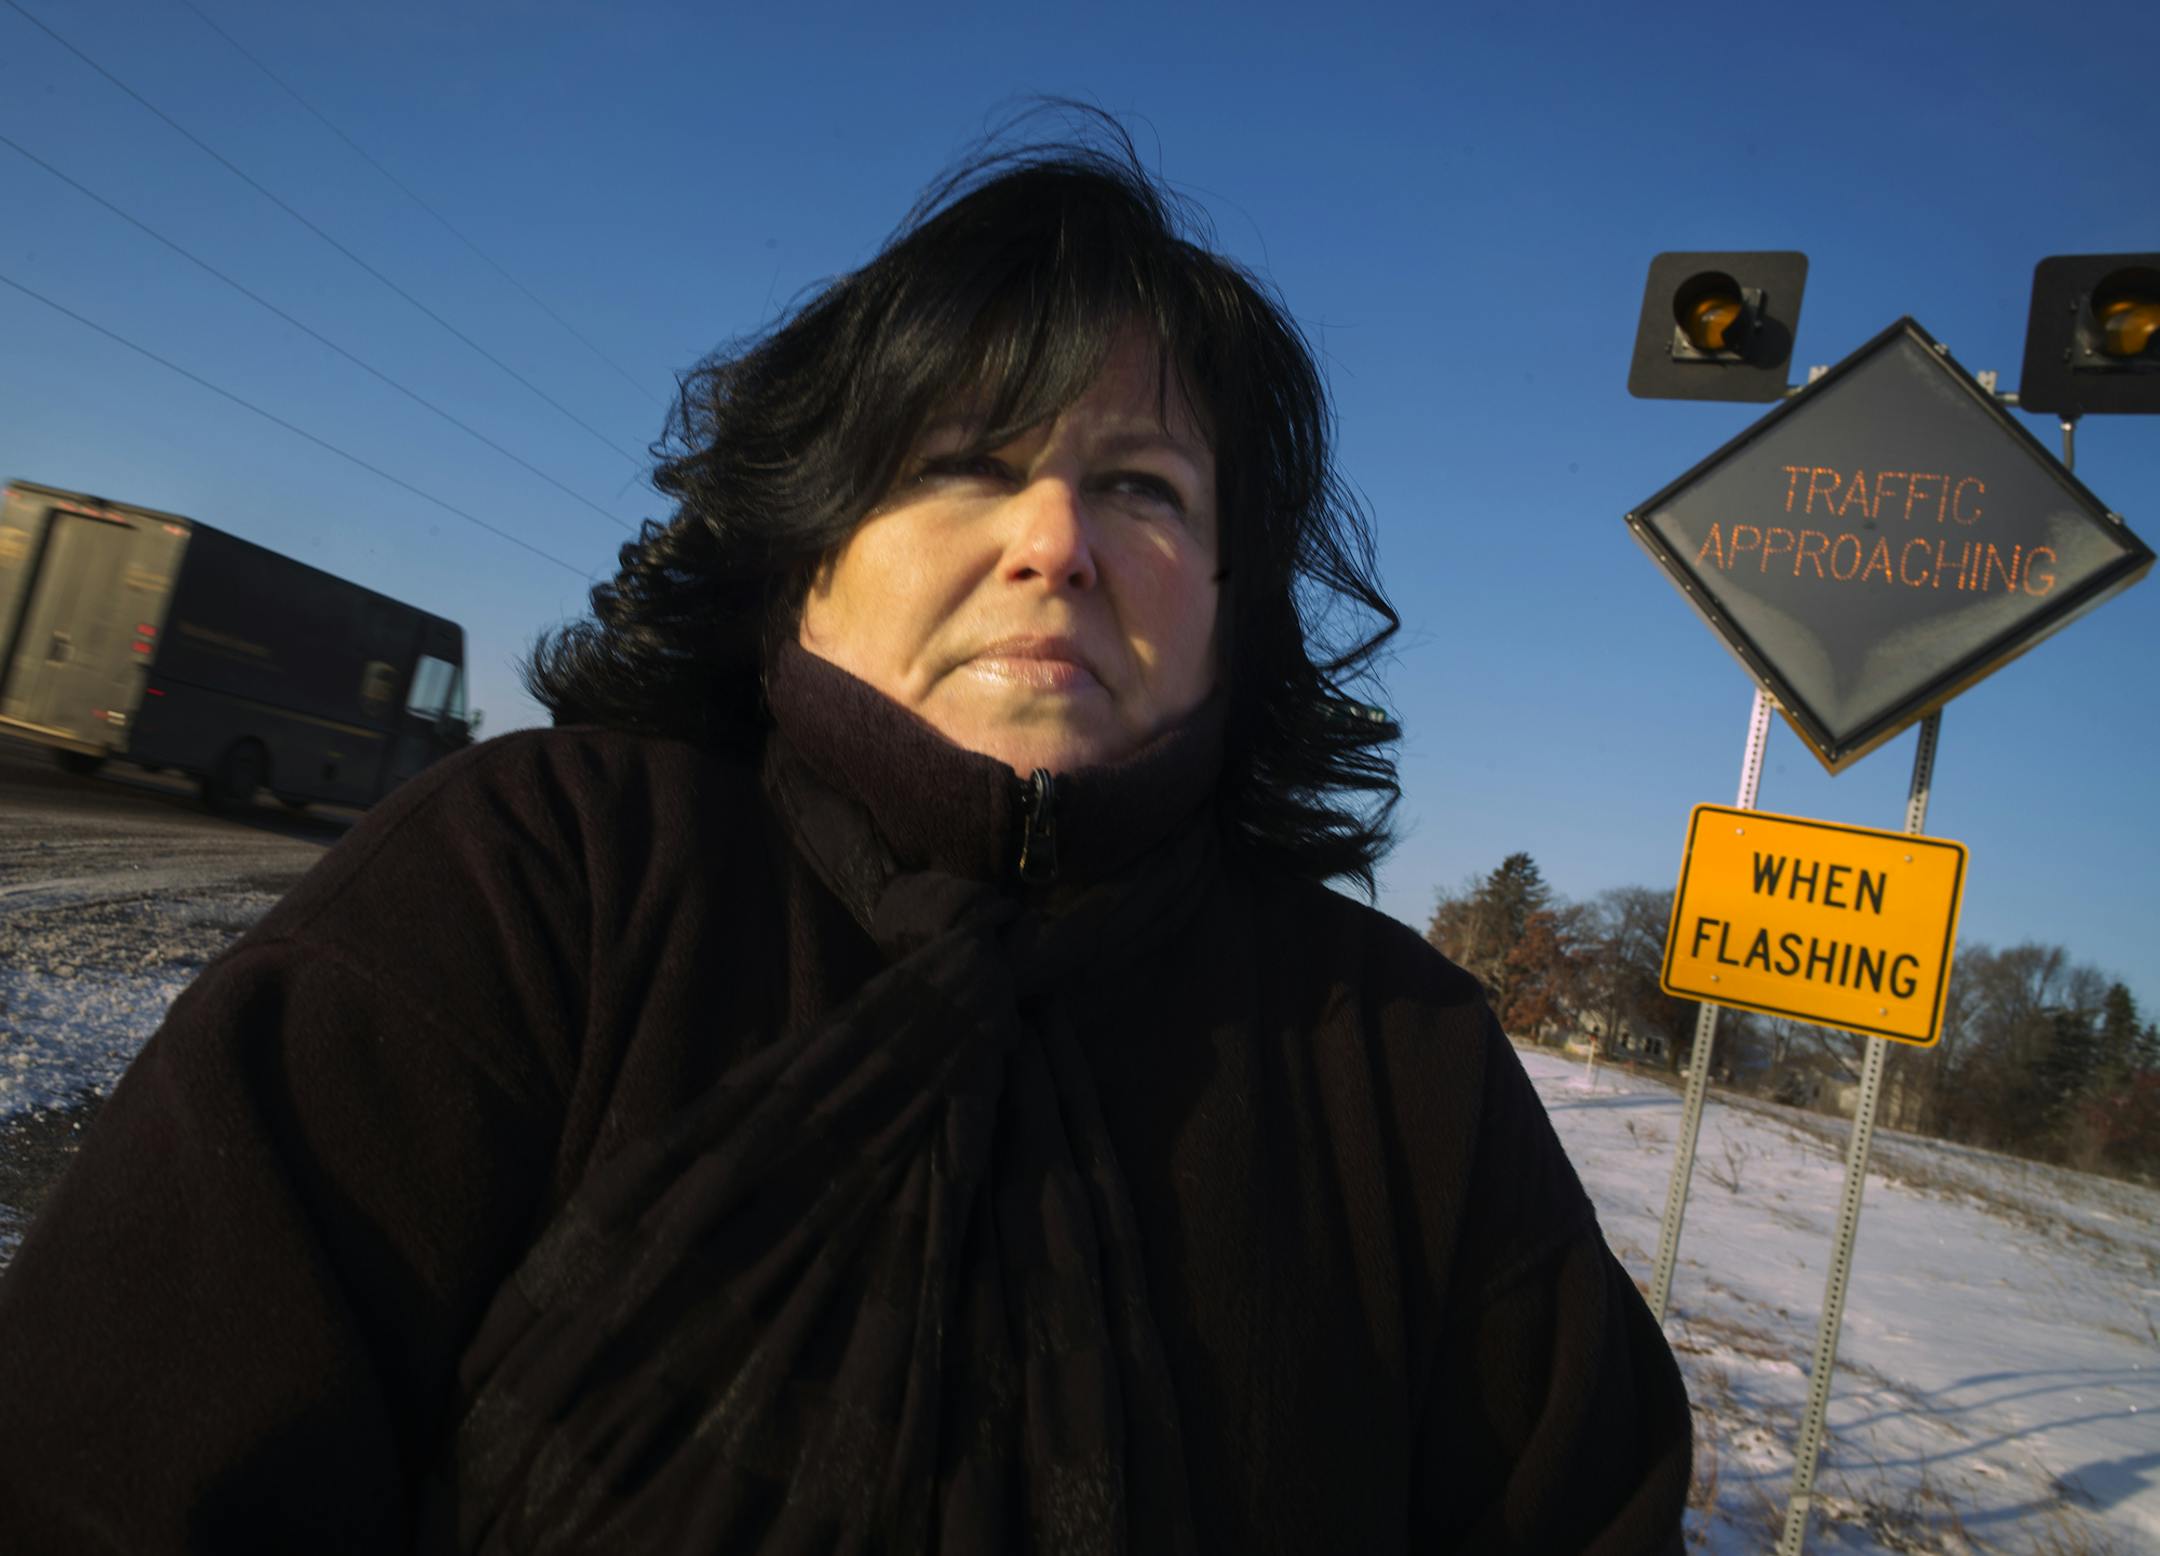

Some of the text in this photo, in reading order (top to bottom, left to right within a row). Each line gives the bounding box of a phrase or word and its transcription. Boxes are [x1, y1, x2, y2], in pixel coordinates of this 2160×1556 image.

[1781, 465, 1985, 525] TRAFFIC
[1695, 522, 2057, 597] APPROACHING
[1753, 852, 1886, 915] WHEN
[1691, 917, 1919, 999] FLASHING
